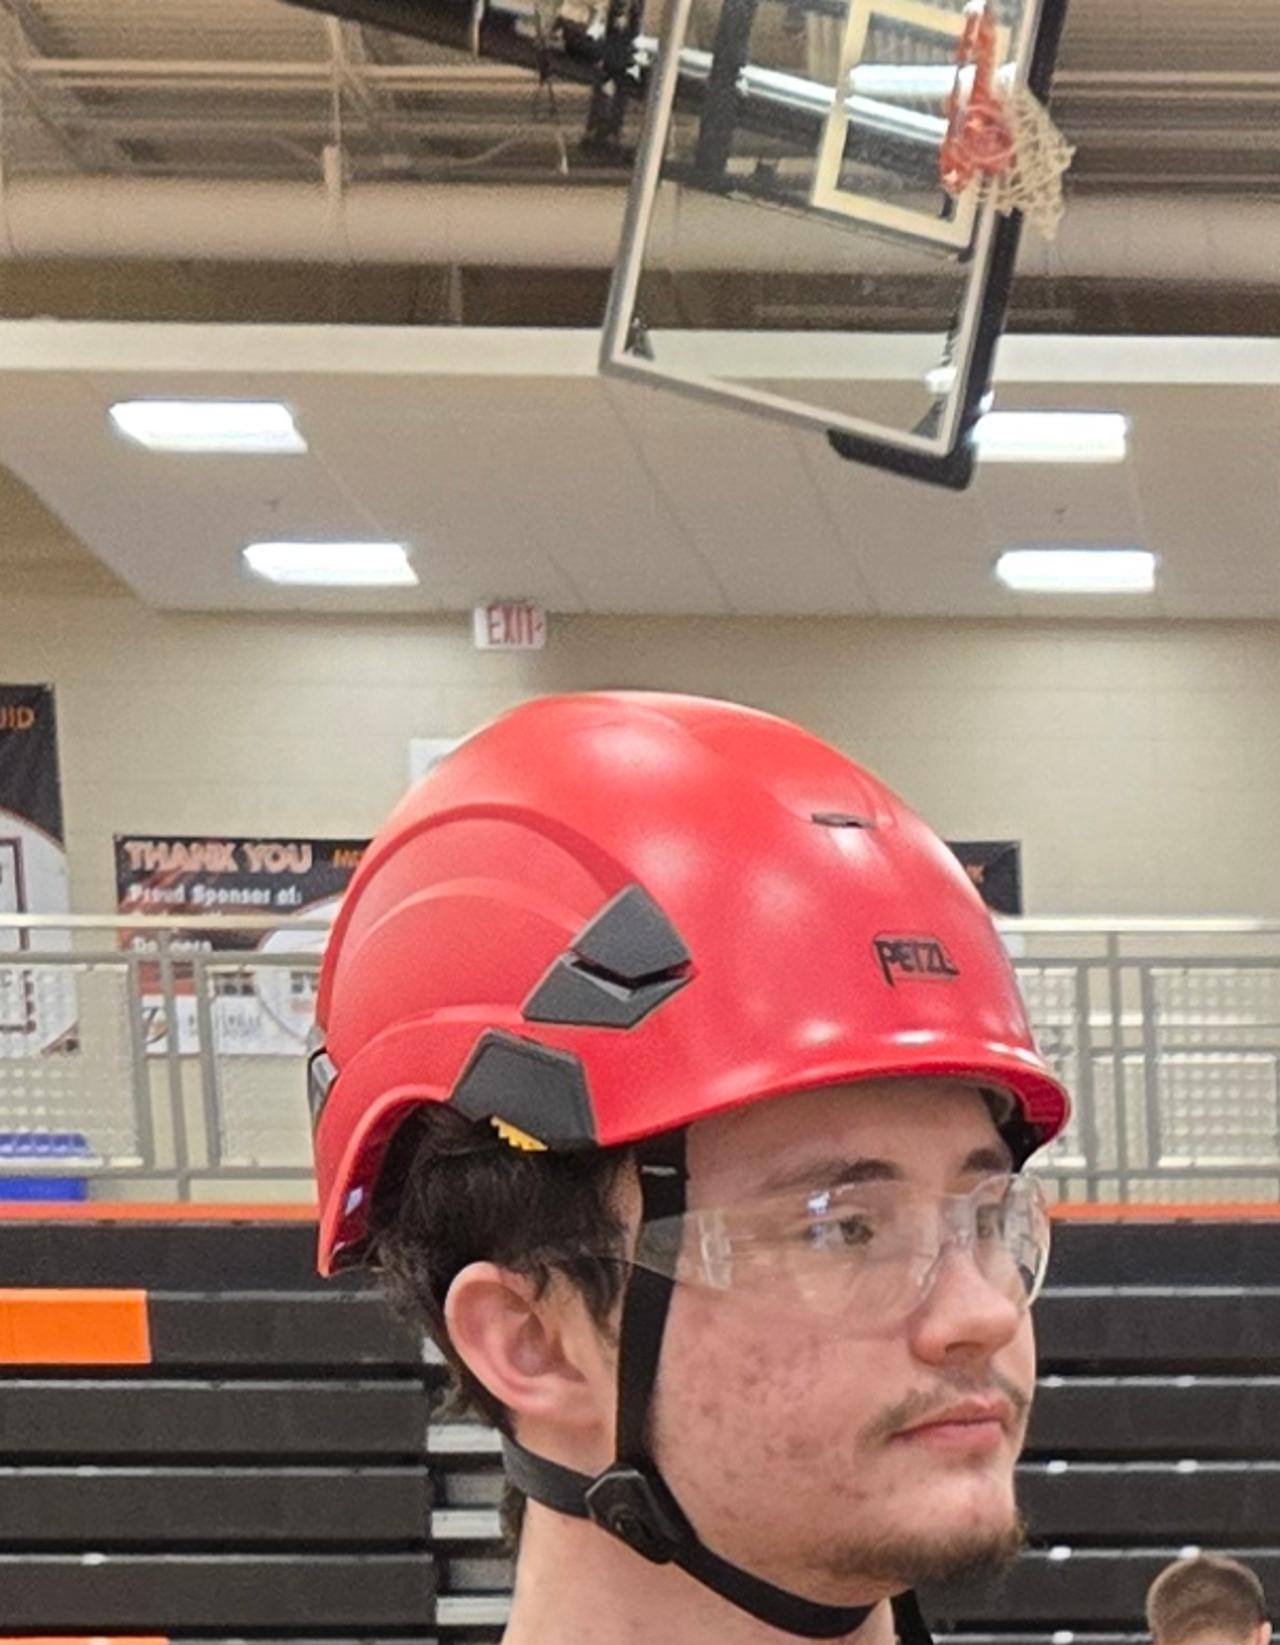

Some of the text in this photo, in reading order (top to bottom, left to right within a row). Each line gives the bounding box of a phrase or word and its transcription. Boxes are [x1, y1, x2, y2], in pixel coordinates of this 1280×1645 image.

[487, 601, 535, 645] EXIT
[124, 841, 239, 872] THANK
[243, 843, 312, 874] YOU
[190, 885, 271, 907] Sponsor
[873, 938, 960, 988] PETZL
